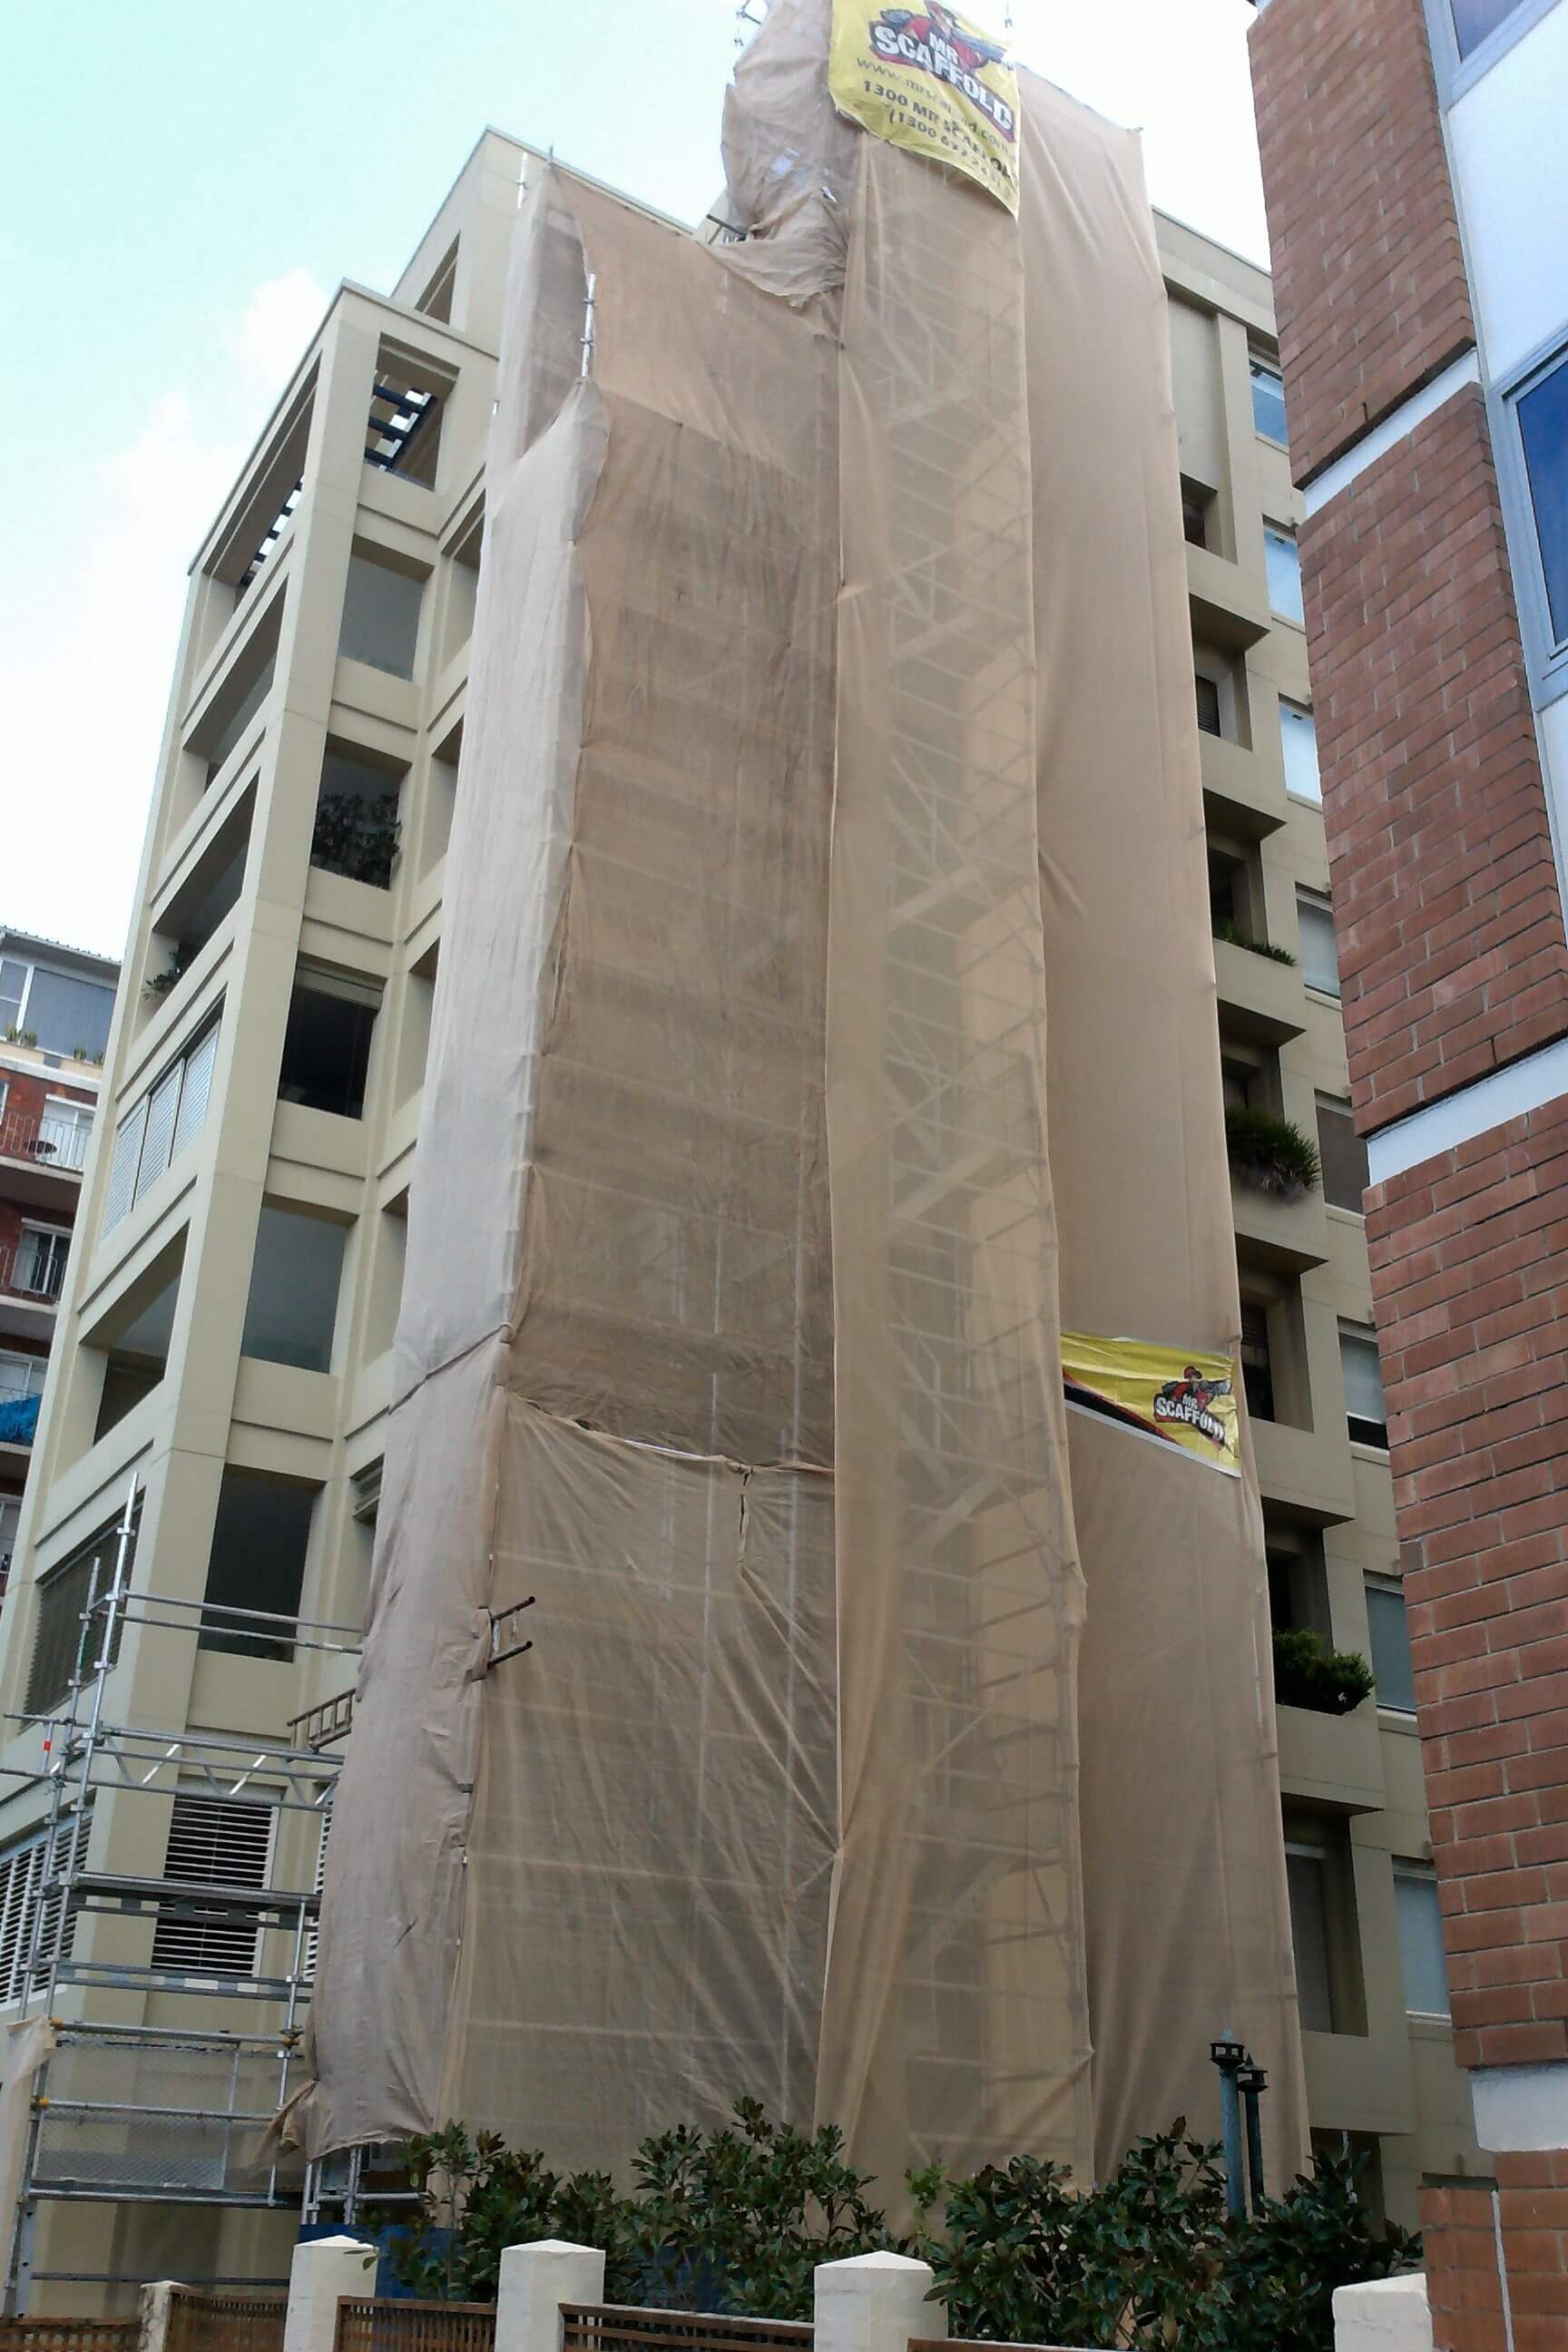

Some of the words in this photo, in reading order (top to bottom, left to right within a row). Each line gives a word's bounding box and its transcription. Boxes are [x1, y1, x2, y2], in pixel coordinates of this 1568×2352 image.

[929, 32, 958, 64] MR
[864, 81, 907, 106] 1300
[874, 25, 1014, 131] SCAFFOLD
[889, 109, 936, 137] (1300
[1155, 1396, 1224, 1440] SCAFFOLD
